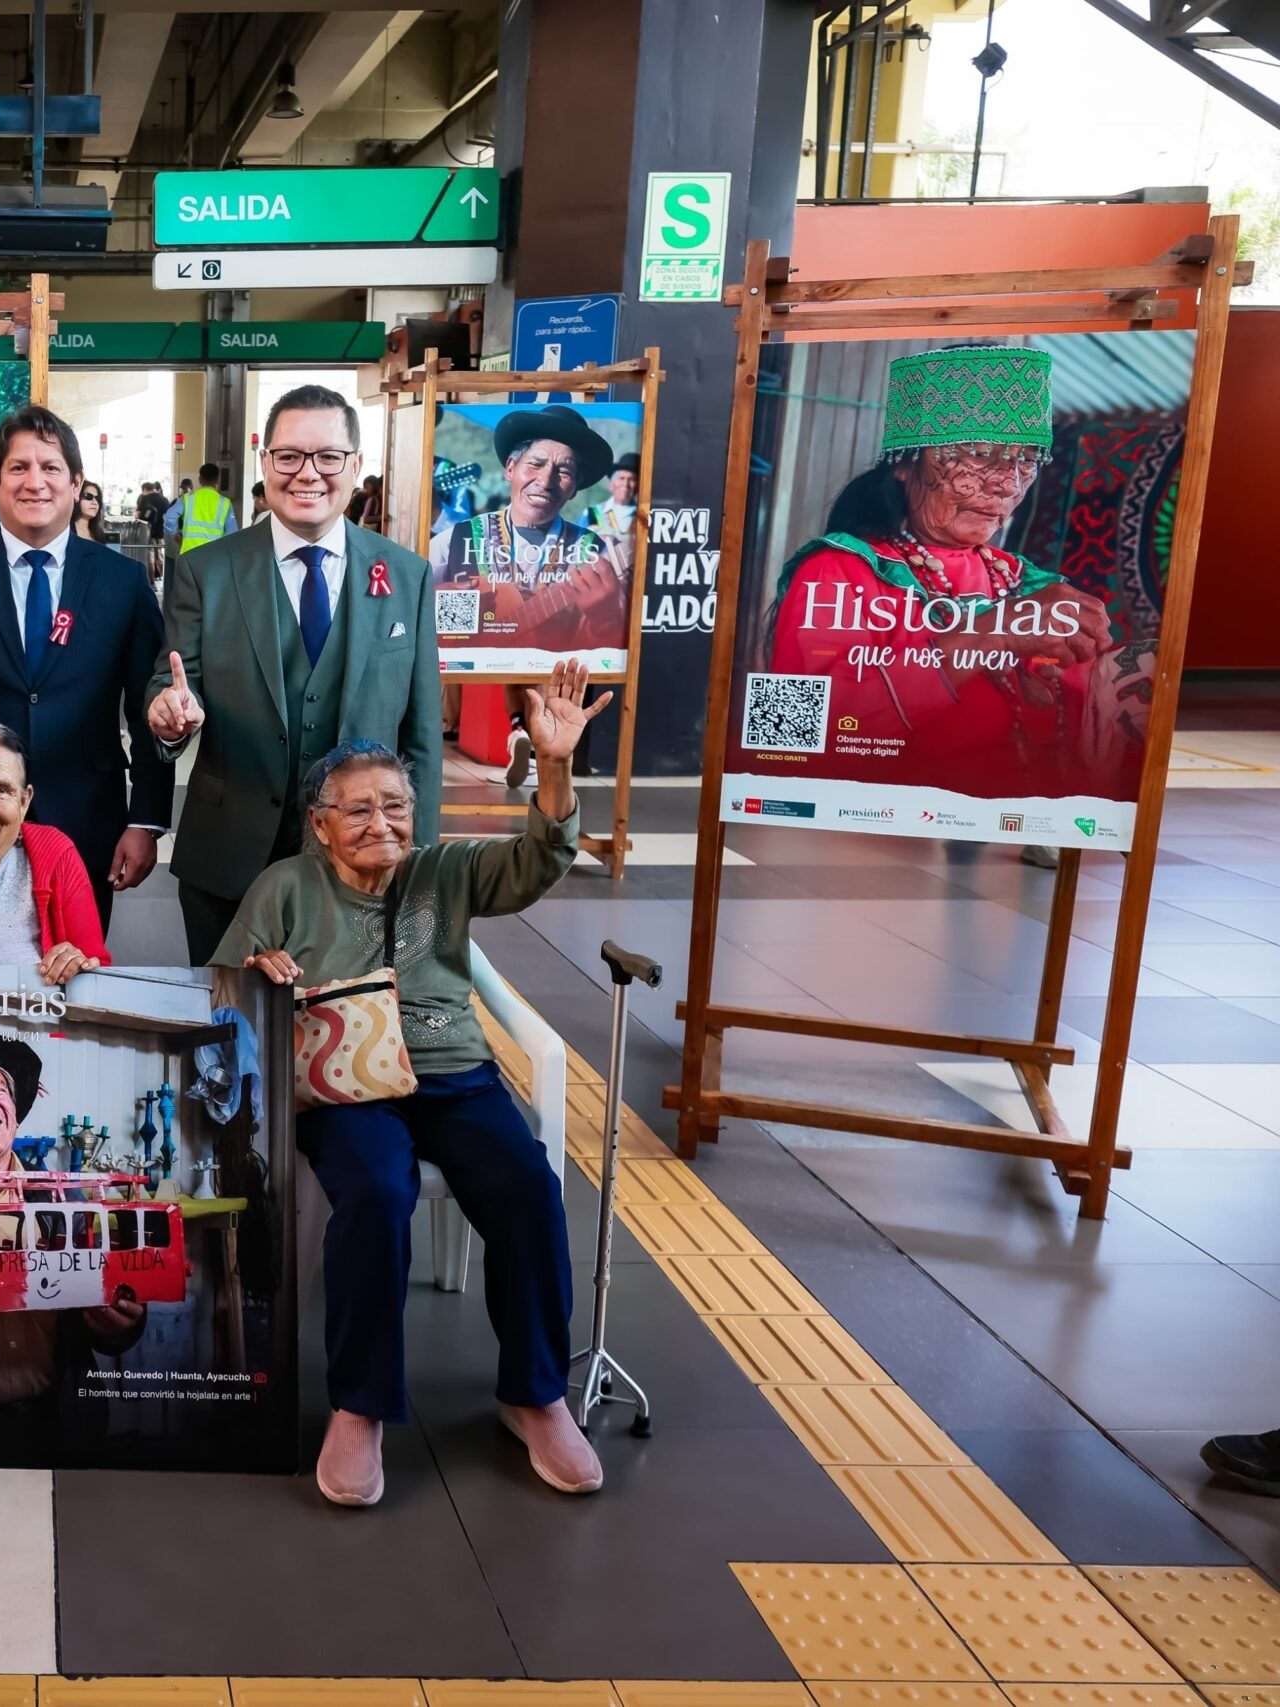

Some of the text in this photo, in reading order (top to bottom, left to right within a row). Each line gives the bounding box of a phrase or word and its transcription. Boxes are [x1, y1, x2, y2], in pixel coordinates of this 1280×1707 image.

[178, 194, 291, 223] SALIDA
[661, 183, 711, 249] S
[552, 327, 567, 335] salir
[48, 334, 95, 348] ALIDA
[220, 333, 279, 348] SALIDA
[647, 509, 709, 544] RA!
[462, 537, 599, 565] Historias
[654, 552, 720, 586] HAY
[486, 571, 572, 592] que nos unen
[798, 580, 1081, 637] Historias
[848, 644, 1019, 683] que nos unen
[836, 734, 906, 746] Observa nuestro
[835, 745, 899, 757] catálogo digital
[954, 820, 976, 828] Nación
[2, 1031, 44, 1042] unen
[59, 1252, 82, 1272] DE
[88, 1251, 108, 1271] LA
[120, 1250, 165, 1272] VIDA
[86, 1370, 122, 1379] Antonio
[124, 1370, 163, 1380] Quevedo
[170, 1371, 205, 1382] Huanta,
[206, 1372, 250, 1383] Ayacucho
[78, 1388, 87, 1397] El
[88, 1388, 120, 1398] hombre
[122, 1391, 138, 1400] que
[140, 1390, 175, 1399] convirtió
[176, 1390, 184, 1399] la
[186, 1390, 220, 1401] hojalata
[234, 1392, 250, 1400] arte
